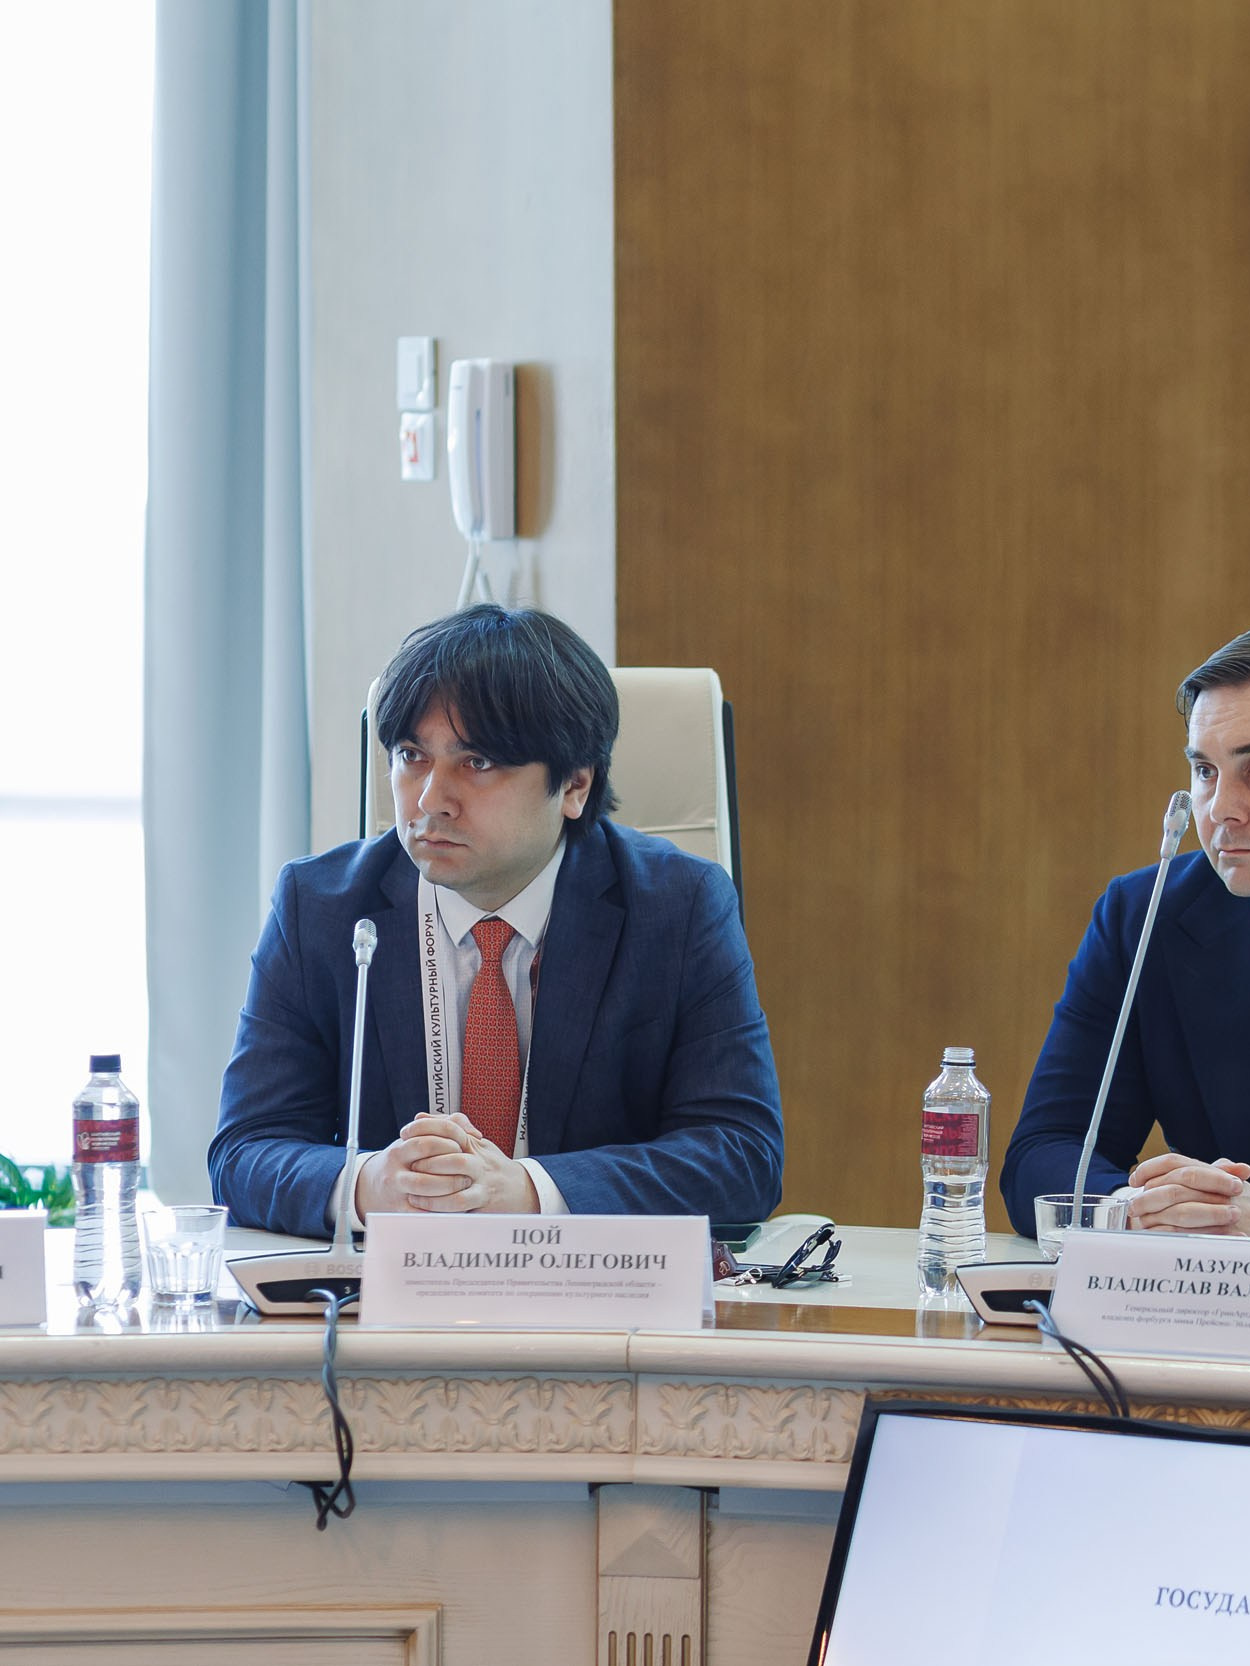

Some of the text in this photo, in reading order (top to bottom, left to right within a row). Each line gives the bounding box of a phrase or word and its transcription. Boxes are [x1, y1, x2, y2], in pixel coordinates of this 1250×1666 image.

[424, 913, 436, 957] ФОРУМ
[425, 959, 441, 1037] КУЛЬТУРНЫЙ
[512, 1225, 561, 1246] ЦОЙ
[403, 1251, 667, 1271] ВЛАДИМИР ОЛЕГОВИЧ
[344, 1286, 351, 1294] 3
[1087, 1275, 1211, 1296] ВЛАДИСЛАВ
